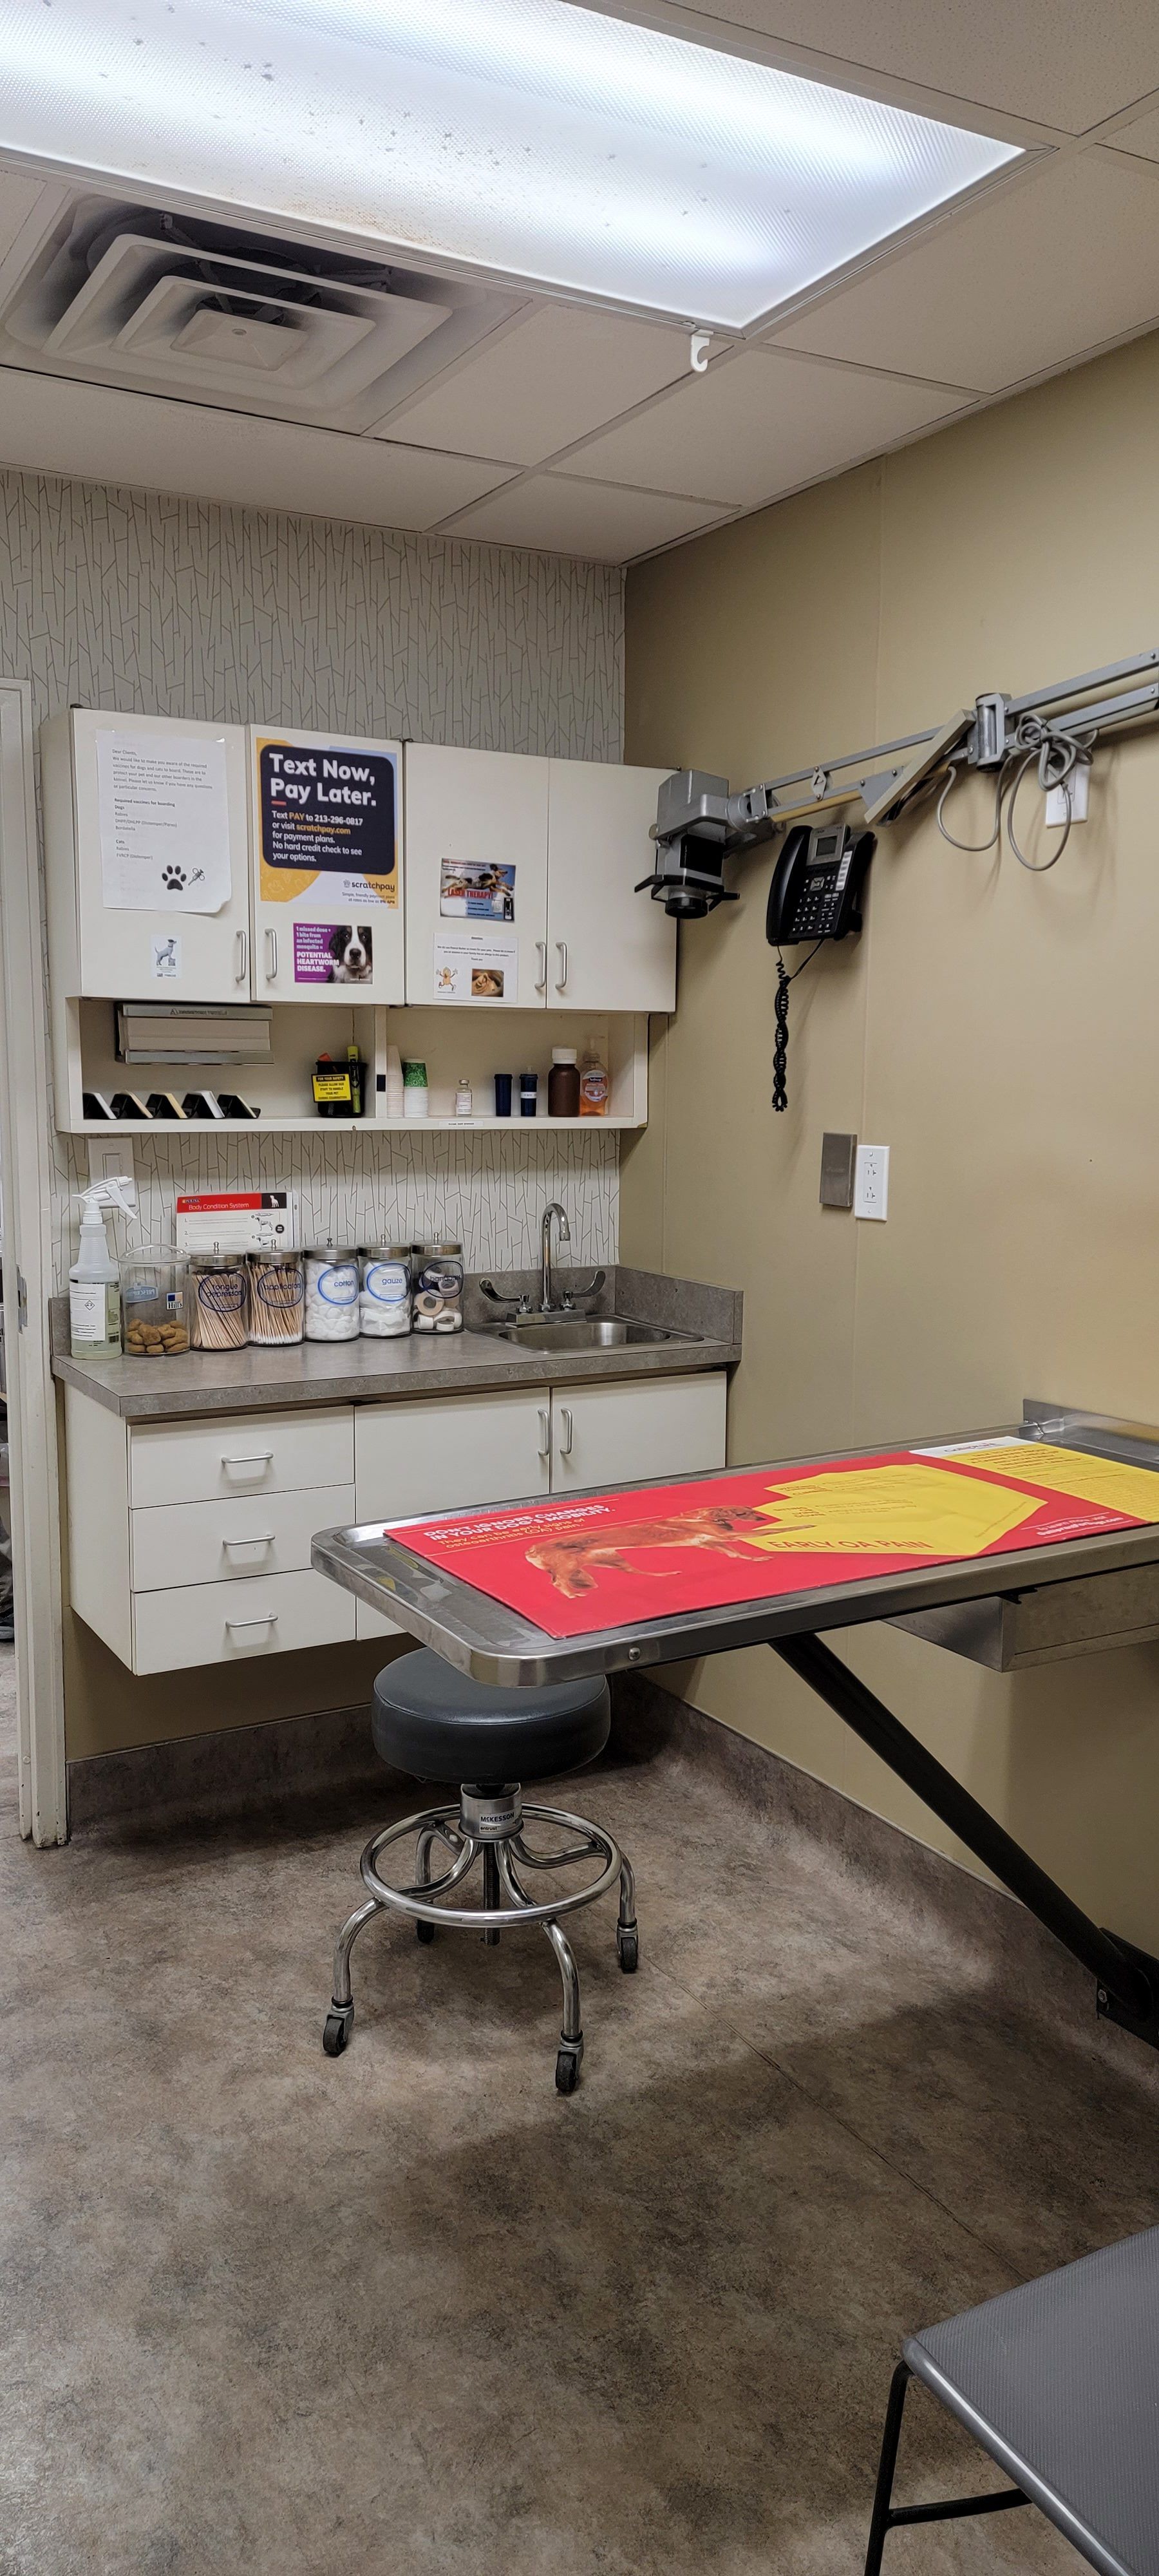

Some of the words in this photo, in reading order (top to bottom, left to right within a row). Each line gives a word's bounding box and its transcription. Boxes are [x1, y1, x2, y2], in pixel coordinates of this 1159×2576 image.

[269, 753, 317, 777] Text
[323, 759, 375, 786] Now,
[270, 778, 311, 804] Pay
[317, 782, 376, 806] Later.
[272, 811, 288, 820] Text
[289, 812, 305, 820] PAY
[306, 813, 313, 822] to
[314, 814, 363, 826] 213-296-0817
[281, 822, 295, 830] visit
[296, 824, 351, 835] scratchpay.com
[284, 833, 314, 843] payment
[316, 835, 335, 844] plans.
[322, 846, 341, 854] check
[290, 854, 317, 862] options.
[352, 881, 395, 893] scratchpay
[334, 1279, 354, 1287] cotton
[473, 1515, 533, 1528] IGNORE
[534, 1505, 605, 1519] CHANGES
[448, 1528, 494, 1537] YOUR
[495, 1519, 544, 1530] DOG'S
[767, 1540, 835, 1549] EARLY
[838, 1540, 879, 1549] OA
[874, 1540, 935, 1549] PAIN
